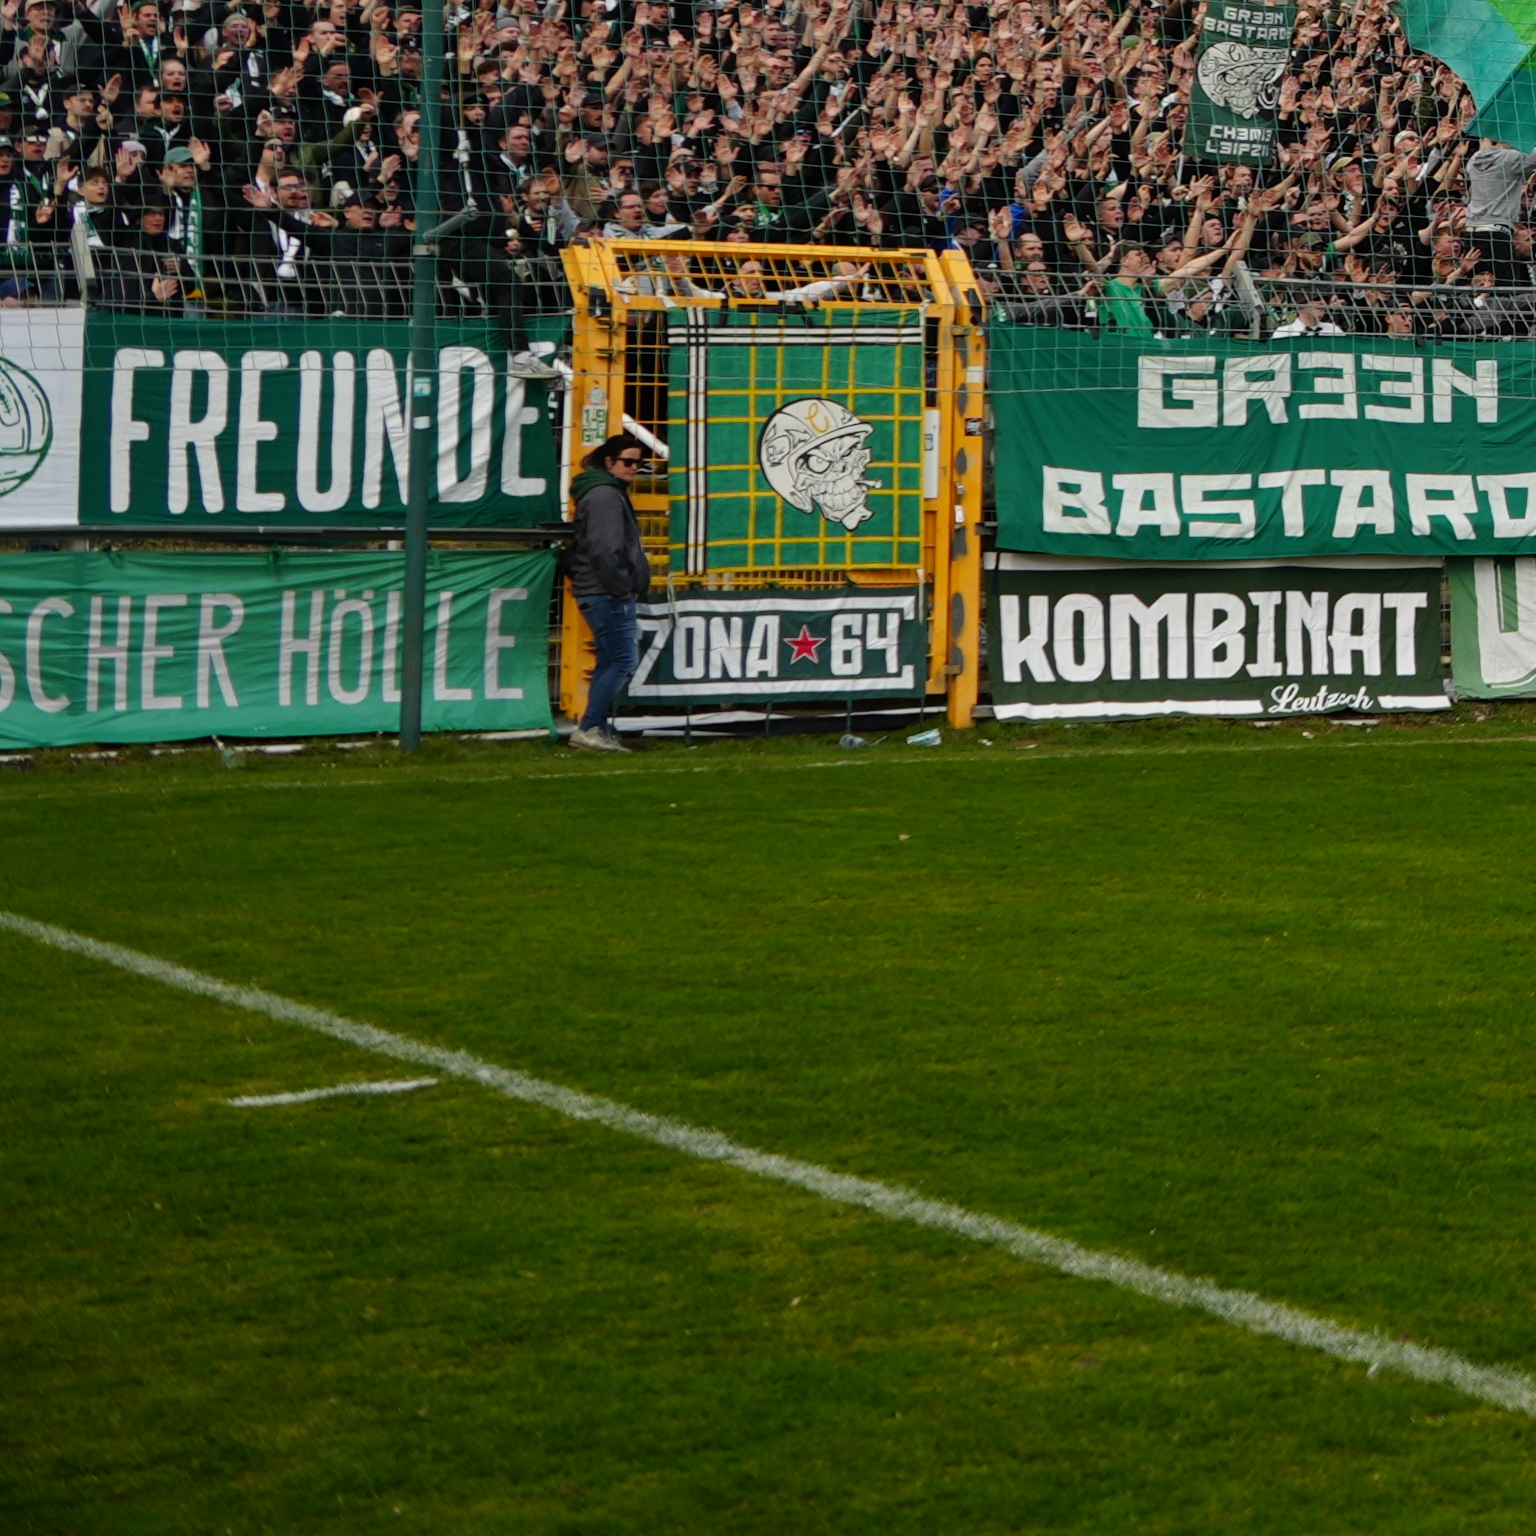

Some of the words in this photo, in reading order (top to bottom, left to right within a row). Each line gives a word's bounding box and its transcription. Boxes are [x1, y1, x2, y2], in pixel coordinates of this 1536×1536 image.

[110, 343, 557, 514] FREUNDE
[279, 586, 530, 707] HÖLLE
[629, 614, 781, 695] ZONA
[830, 612, 901, 676] 64
[998, 591, 1429, 684] KOMBINAT
